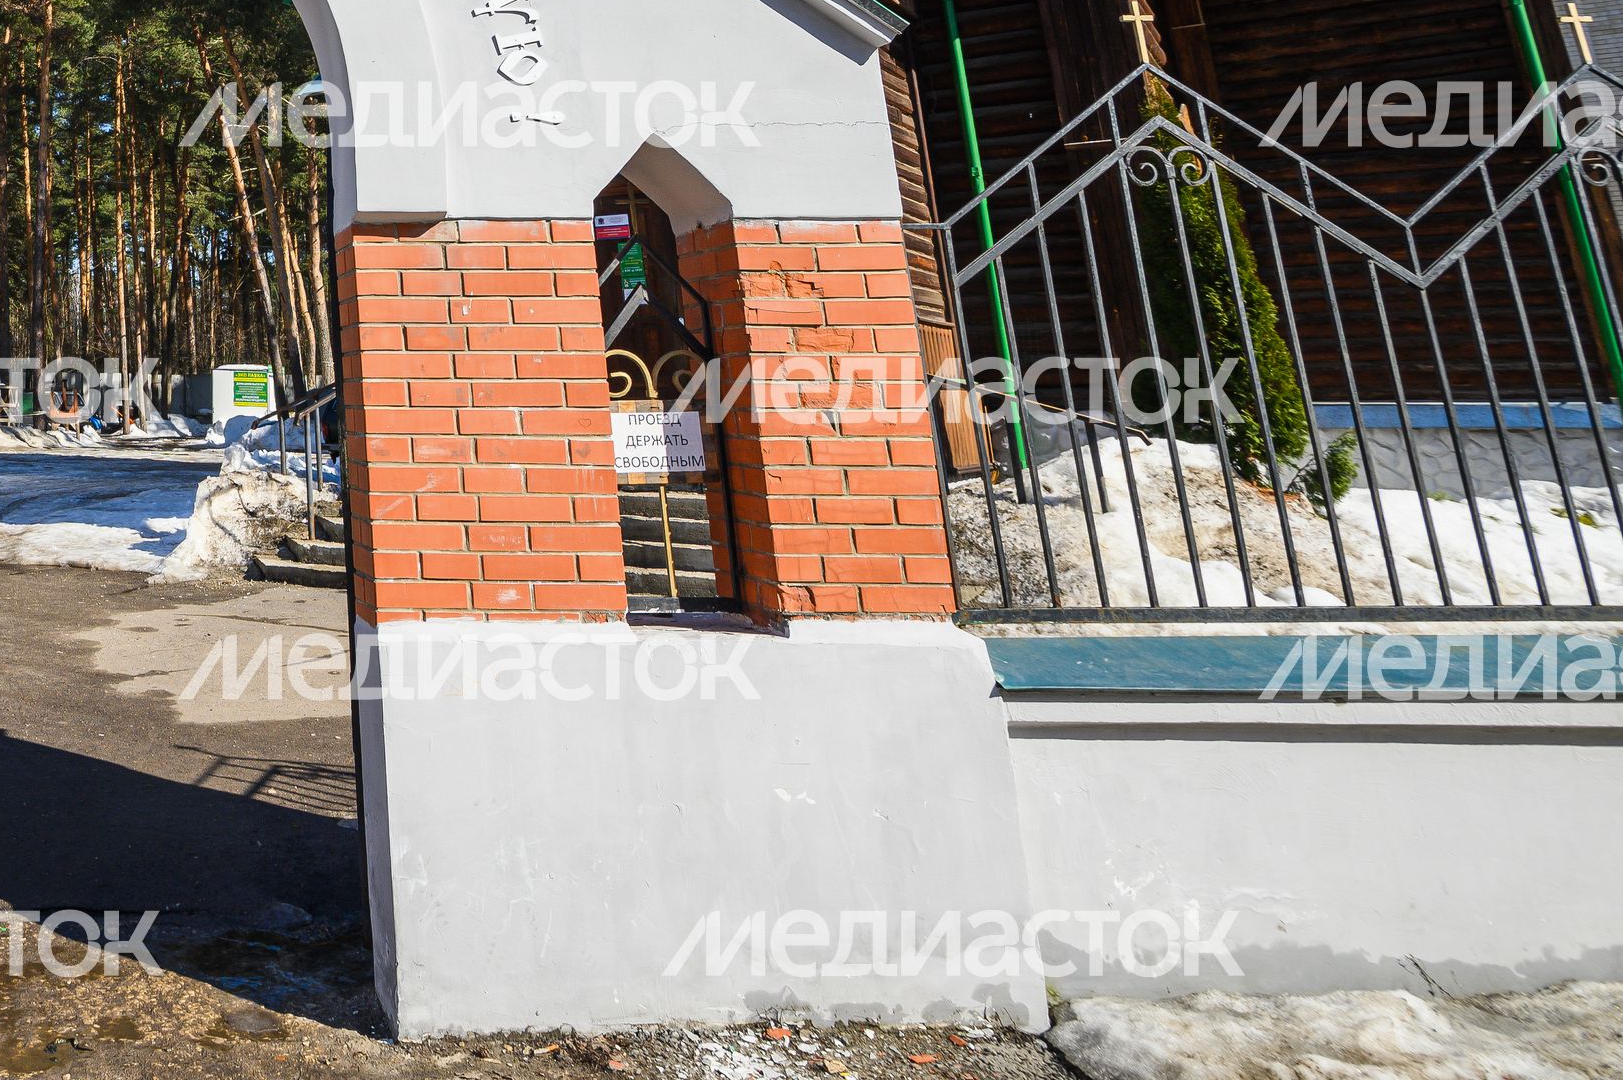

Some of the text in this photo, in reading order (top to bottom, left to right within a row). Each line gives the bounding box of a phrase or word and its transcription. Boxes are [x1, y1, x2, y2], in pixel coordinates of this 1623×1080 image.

[628, 413, 682, 427] ПРОЕЗД
[625, 434, 689, 449] ДЕРЖАТЬ
[614, 455, 705, 470] СВОБОДНЫМ
